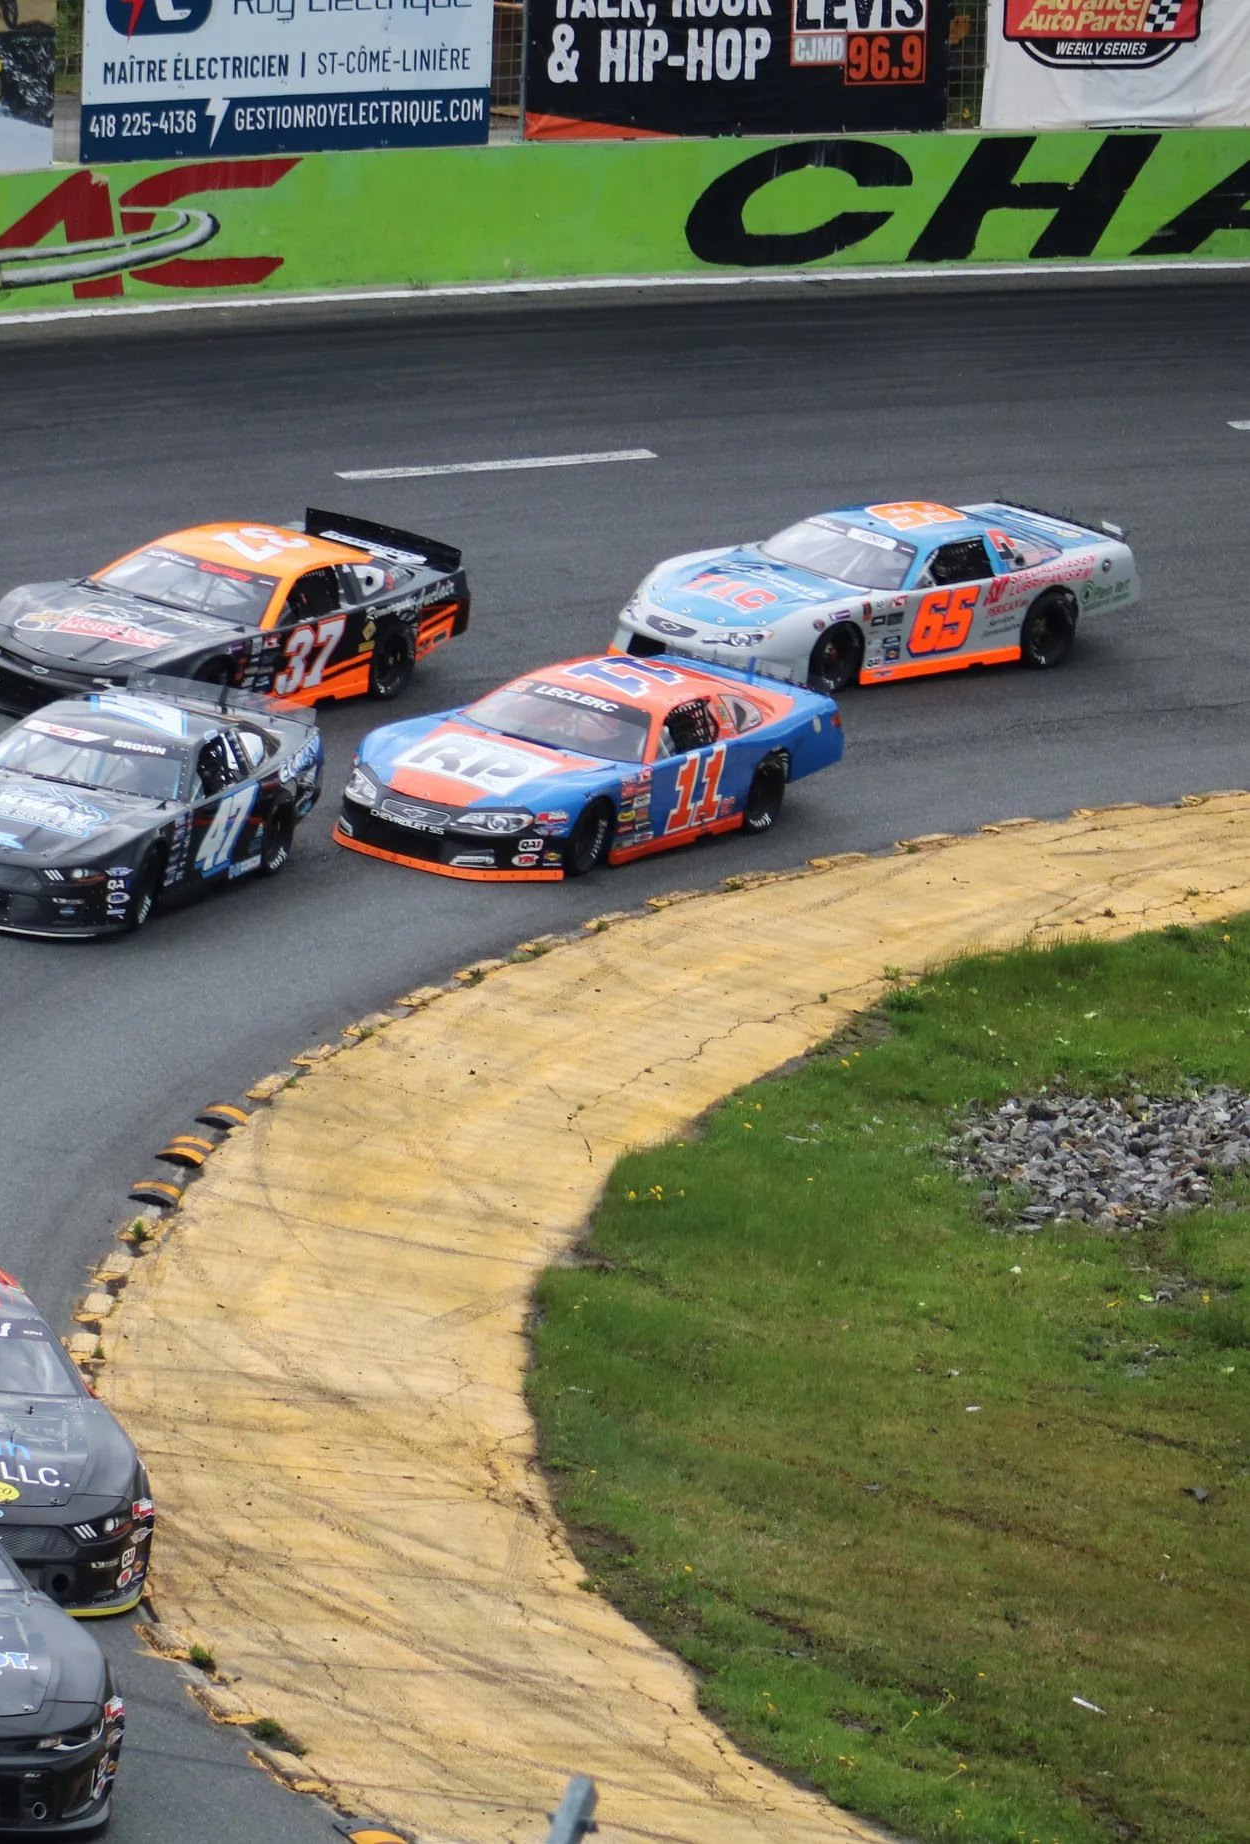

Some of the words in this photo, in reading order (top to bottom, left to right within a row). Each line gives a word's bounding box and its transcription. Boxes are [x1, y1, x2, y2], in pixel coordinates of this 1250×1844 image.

[548, 24, 580, 83] &
[599, 27, 772, 83] HIP-HOP
[794, 36, 844, 62] CJMD
[849, 34, 923, 80] 96.9
[1055, 42, 1103, 56] WEEKLY
[1103, 42, 1147, 56] SERIES
[103, 55, 167, 86] MAÎTRE
[173, 51, 290, 82] ÉLECTRICIEN
[89, 114, 116, 139] 418
[120, 108, 197, 137] 225-4136
[234, 97, 484, 132] GESTIONROYELECTRIQUE.COM
[907, 585, 980, 657] 65
[272, 613, 348, 698] 37
[534, 684, 620, 713] LECLERC
[112, 739, 167, 756] BROWN
[663, 743, 727, 837] 11
[195, 781, 261, 874] 47
[370, 809, 427, 832] CHEVROLET
[0, 1461, 71, 1489] LLC.
